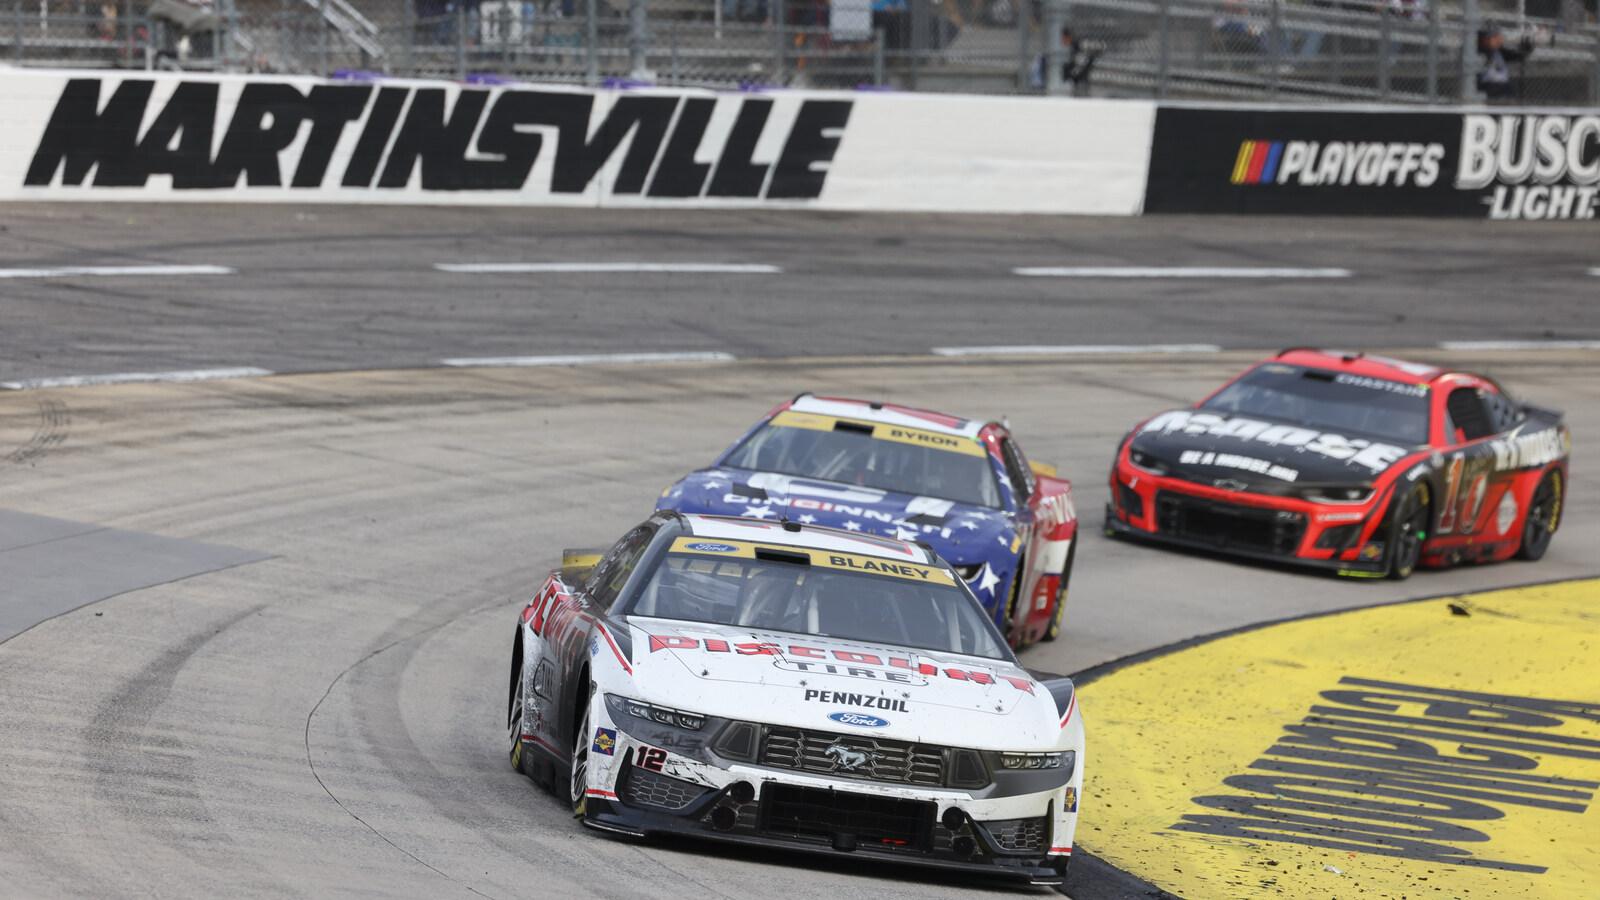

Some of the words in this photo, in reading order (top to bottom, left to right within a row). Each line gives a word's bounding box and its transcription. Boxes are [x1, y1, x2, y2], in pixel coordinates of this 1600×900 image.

[23, 79, 854, 199] MARTINSVILLE
[1276, 141, 1445, 188] PLAYOFFS
[1335, 373, 1428, 398] CHASTAIN
[891, 429, 959, 448] BYRON
[691, 542, 732, 553] Ford
[829, 555, 930, 580] BLANEY
[648, 635, 1036, 697] DISCOUNT
[788, 661, 912, 684] TIRE
[804, 688, 910, 713] PENNZOIL
[835, 711, 882, 728] Ford
[635, 745, 668, 772] 12
